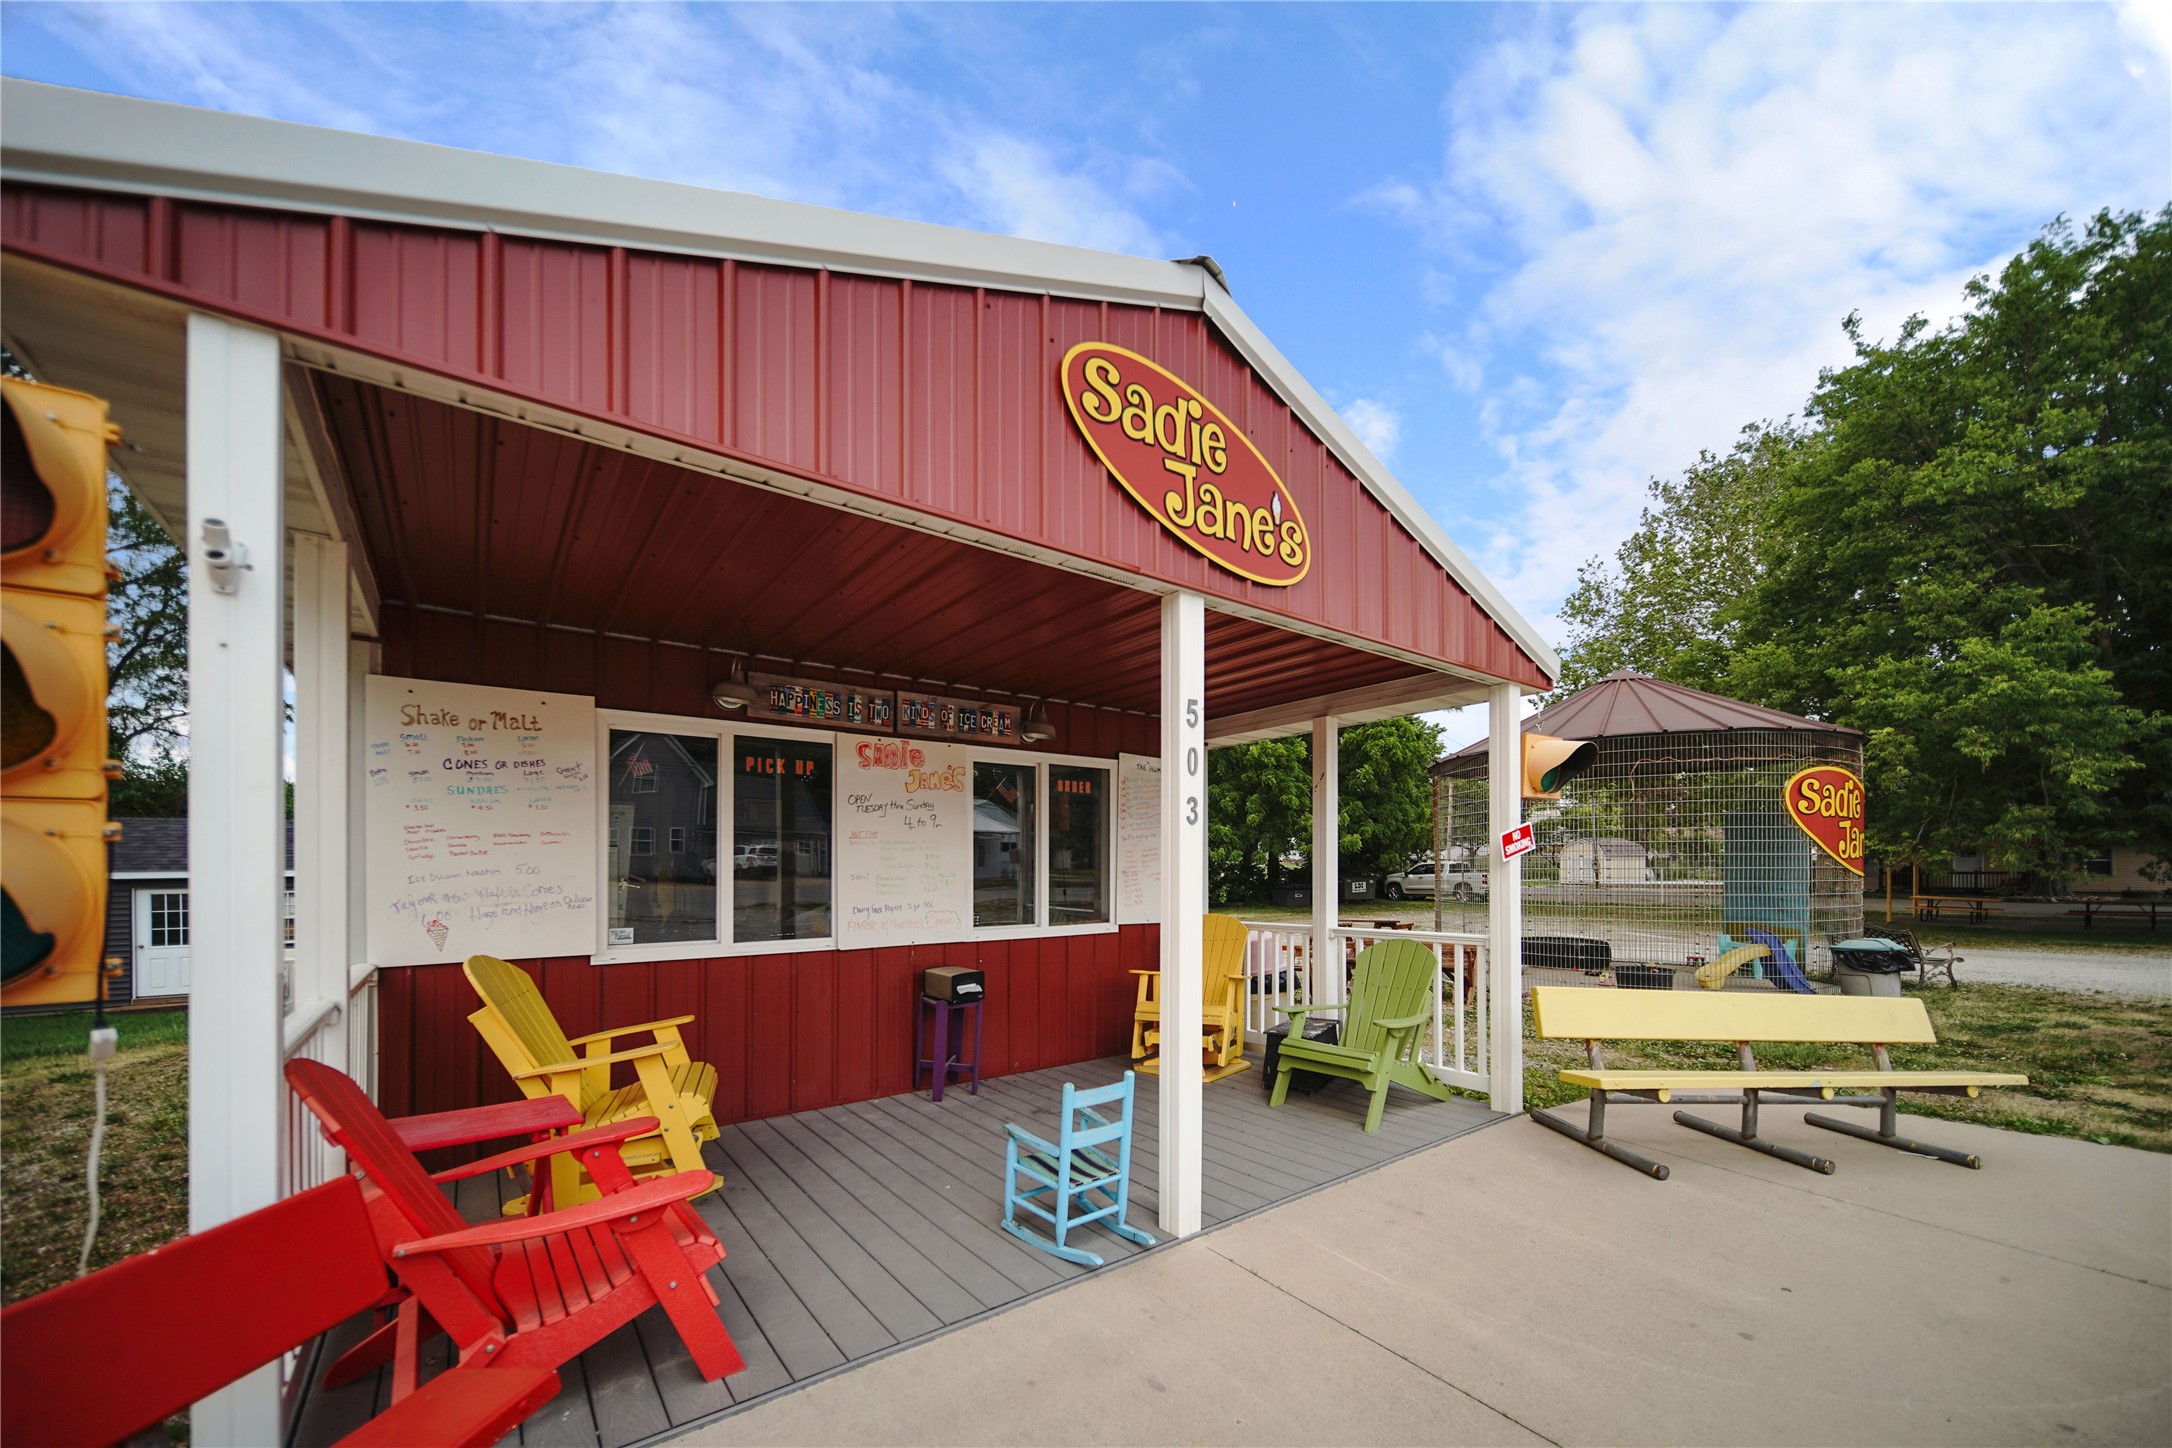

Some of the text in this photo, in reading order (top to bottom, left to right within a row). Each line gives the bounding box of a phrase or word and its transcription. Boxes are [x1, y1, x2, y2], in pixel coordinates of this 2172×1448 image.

[1080, 356, 1228, 474] Sadie
[1163, 457, 1304, 566] Jane's
[400, 704, 543, 731] Shake or Malt
[770, 690, 1011, 731] HAPPINESS IS TWO KINDS OF ICE CREAM
[443, 758, 546, 770] CONES OR DISHES
[745, 756, 815, 776] PICK UP
[447, 785, 509, 795] SUNDAES
[1057, 779, 1091, 794] ORDER
[848, 793, 874, 805] OPEN
[906, 799, 935, 811] Sunday
[1797, 778, 1861, 819] Sadie
[917, 816, 927, 827] to
[1511, 829, 1521, 842] NO
[1505, 836, 1532, 856] SMOKING
[523, 882, 564, 897] Cones
